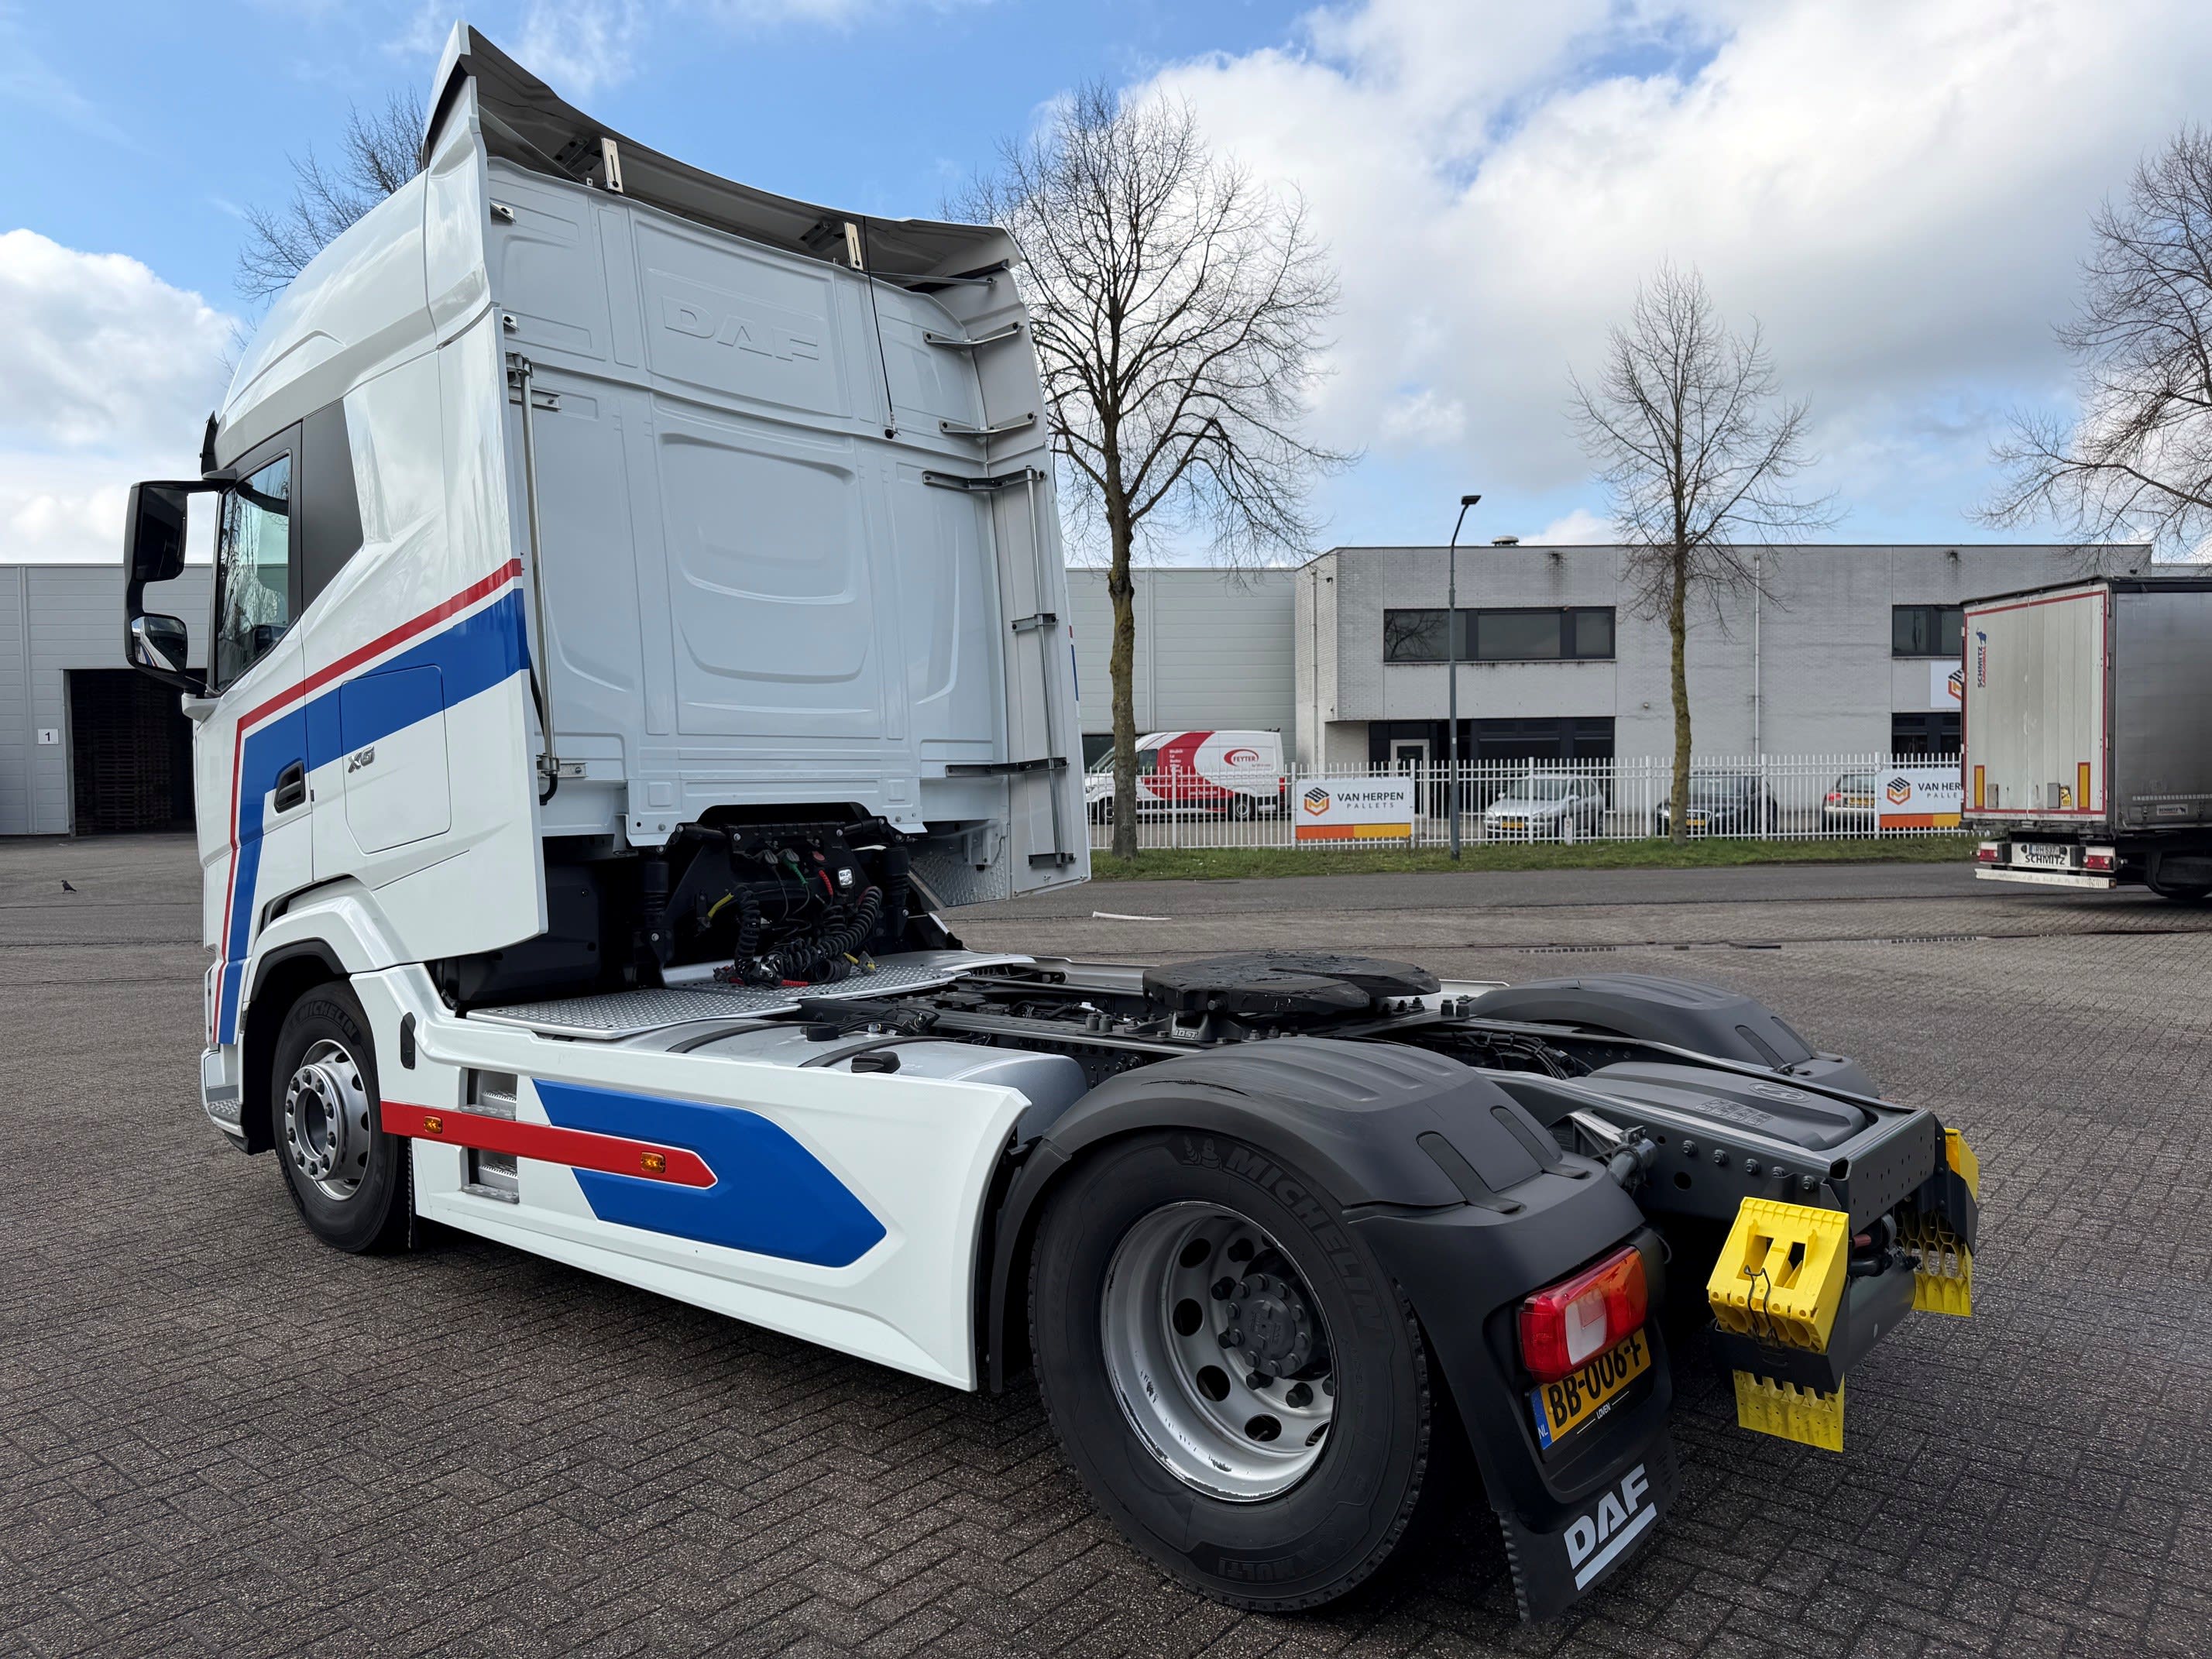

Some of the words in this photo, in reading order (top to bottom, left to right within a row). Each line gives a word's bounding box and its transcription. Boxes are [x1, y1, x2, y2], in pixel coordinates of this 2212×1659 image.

[661, 295, 819, 362] DAF
[45, 731, 50, 742] 1
[348, 745, 375, 774] XG
[1918, 782, 1939, 792] VAN
[1337, 792, 1360, 802] VAN
[1362, 792, 1404, 801] HERPEN
[2025, 854, 2065, 865] SCHMITZ
[297, 1001, 357, 1038] MICHELIN
[1173, 1029, 1198, 1039] JOST
[1225, 1146, 1385, 1332] MICHELIN
[1596, 1402, 1612, 1420] LOVEN
[1537, 1424, 1549, 1440] NL
[1563, 1463, 1650, 1570] DAF
